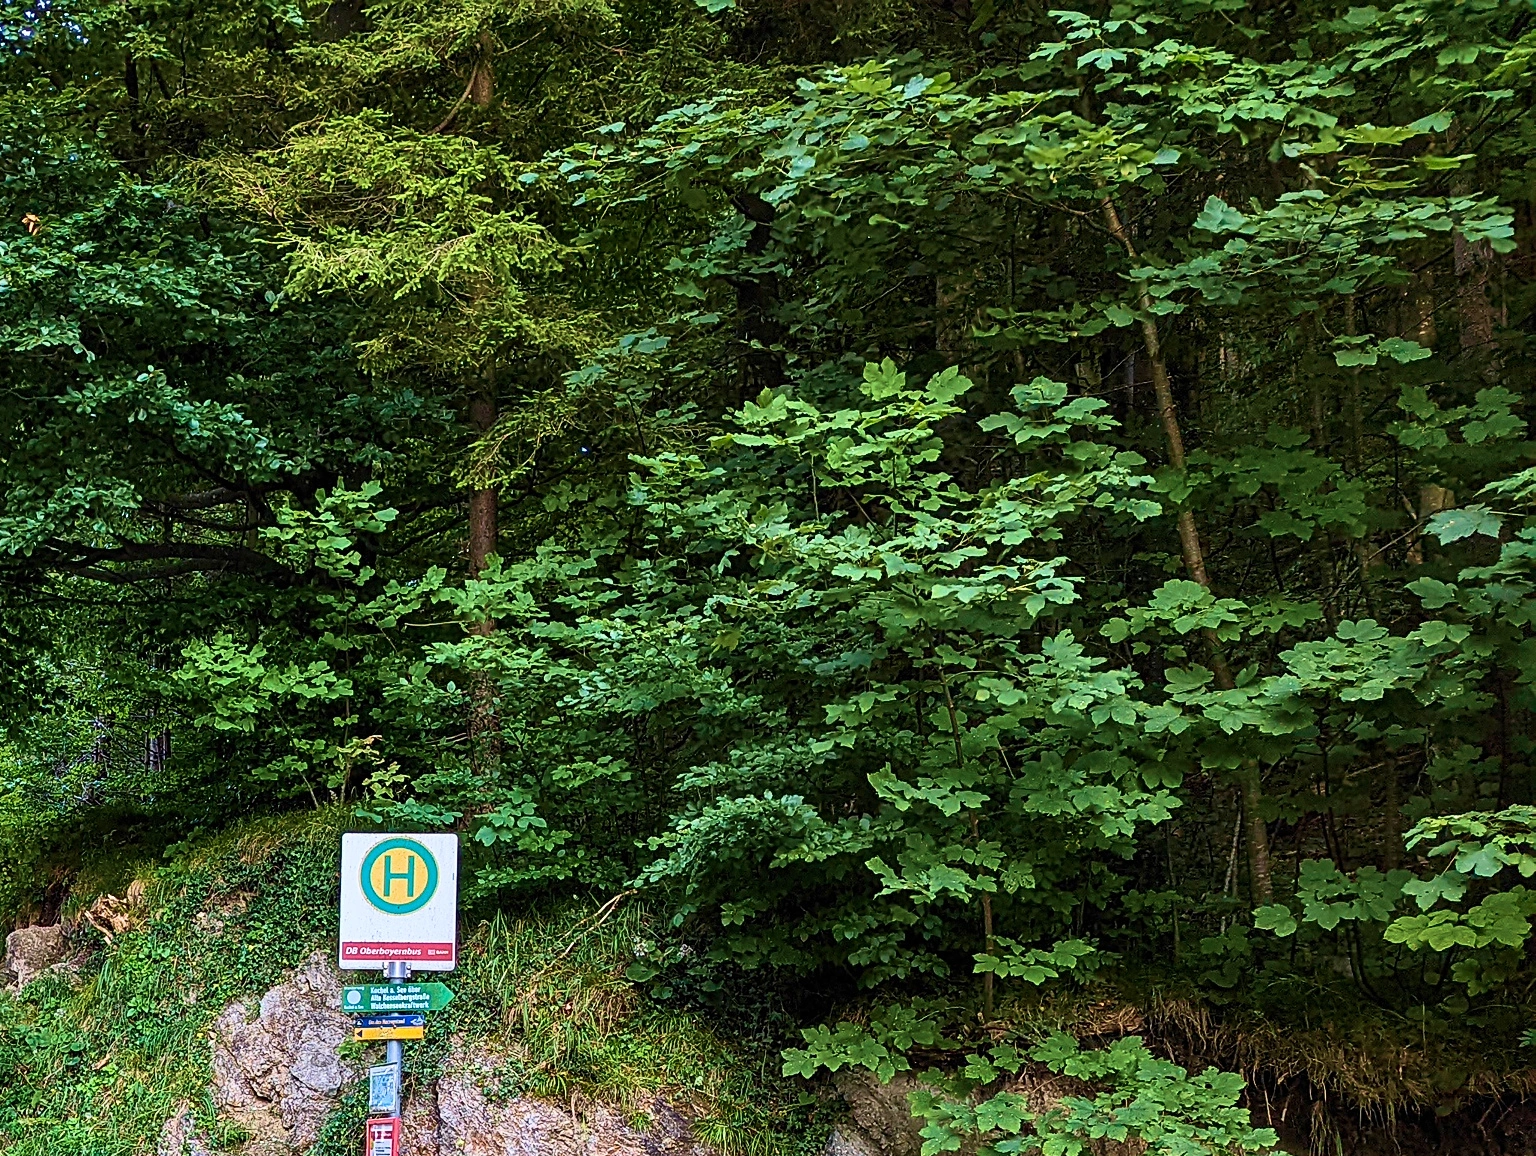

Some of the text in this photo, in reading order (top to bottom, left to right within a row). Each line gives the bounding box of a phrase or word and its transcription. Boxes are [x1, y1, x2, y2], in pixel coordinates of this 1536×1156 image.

[383, 855, 415, 897] H
[345, 946, 422, 957] DB Oberbayernbus
